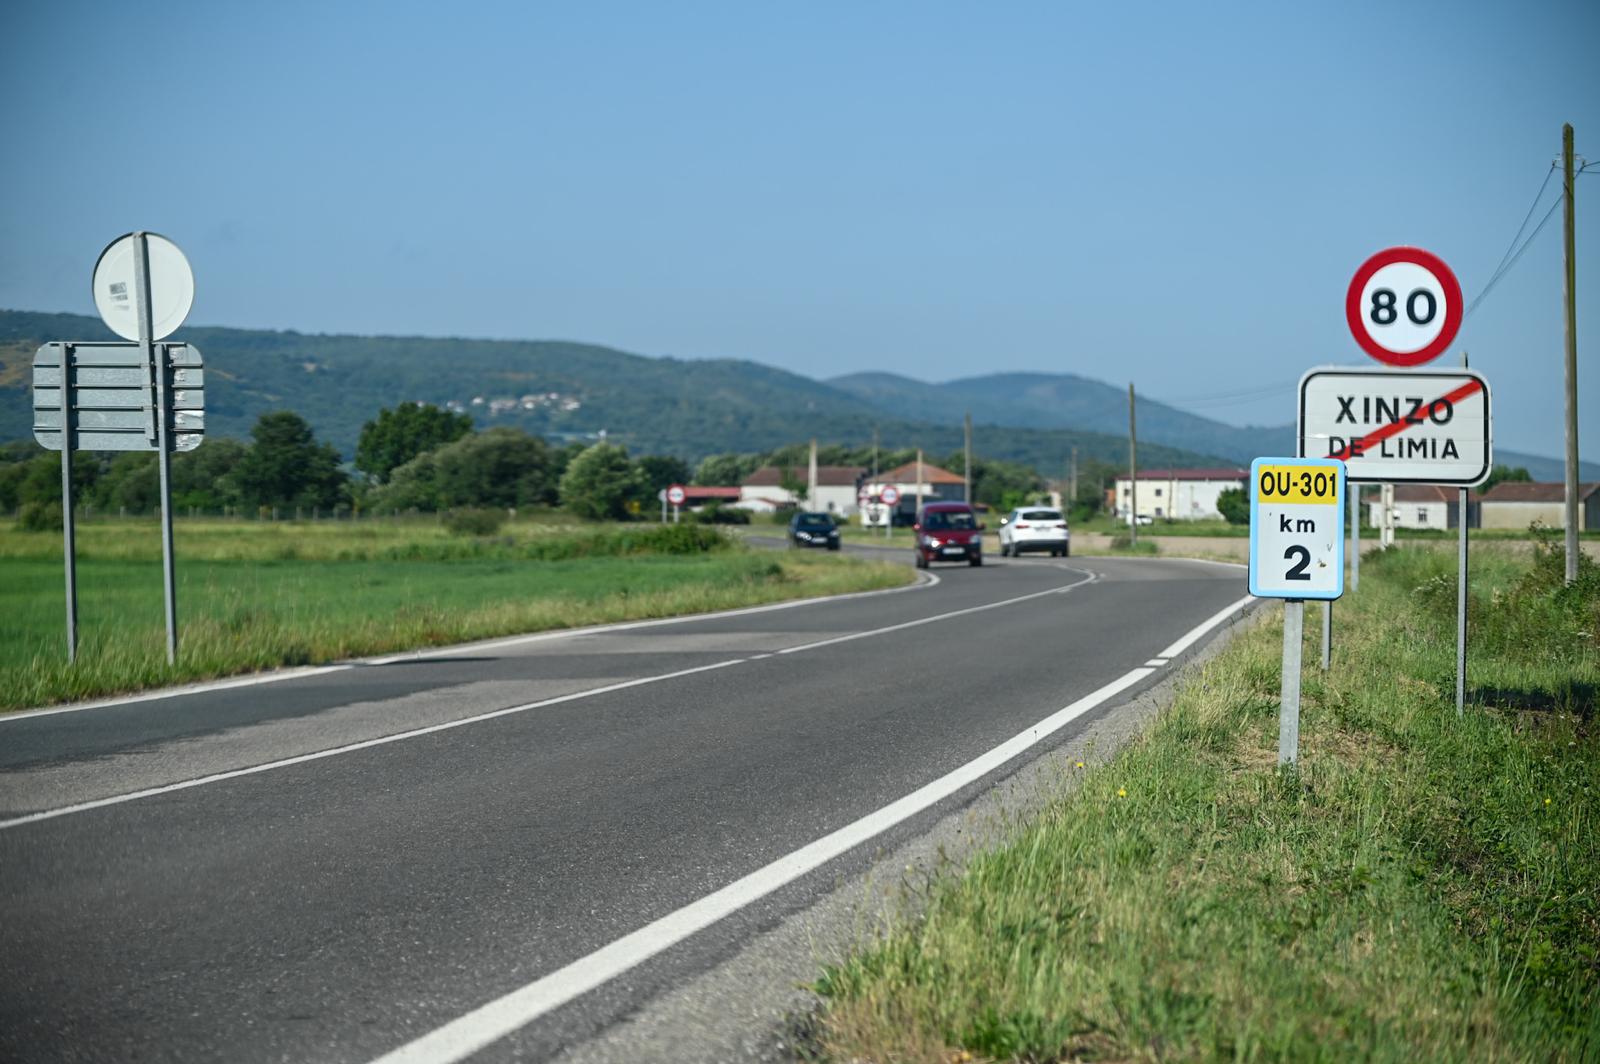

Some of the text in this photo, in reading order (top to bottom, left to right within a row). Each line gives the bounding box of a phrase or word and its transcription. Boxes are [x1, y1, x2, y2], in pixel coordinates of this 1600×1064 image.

[1370, 288, 1437, 325] 80
[1335, 396, 1453, 425] XINZO
[1329, 436, 1459, 459] DE LIMIA
[1260, 471, 1336, 497] OU-301
[1280, 514, 1316, 533] km
[1283, 545, 1311, 581] 2
